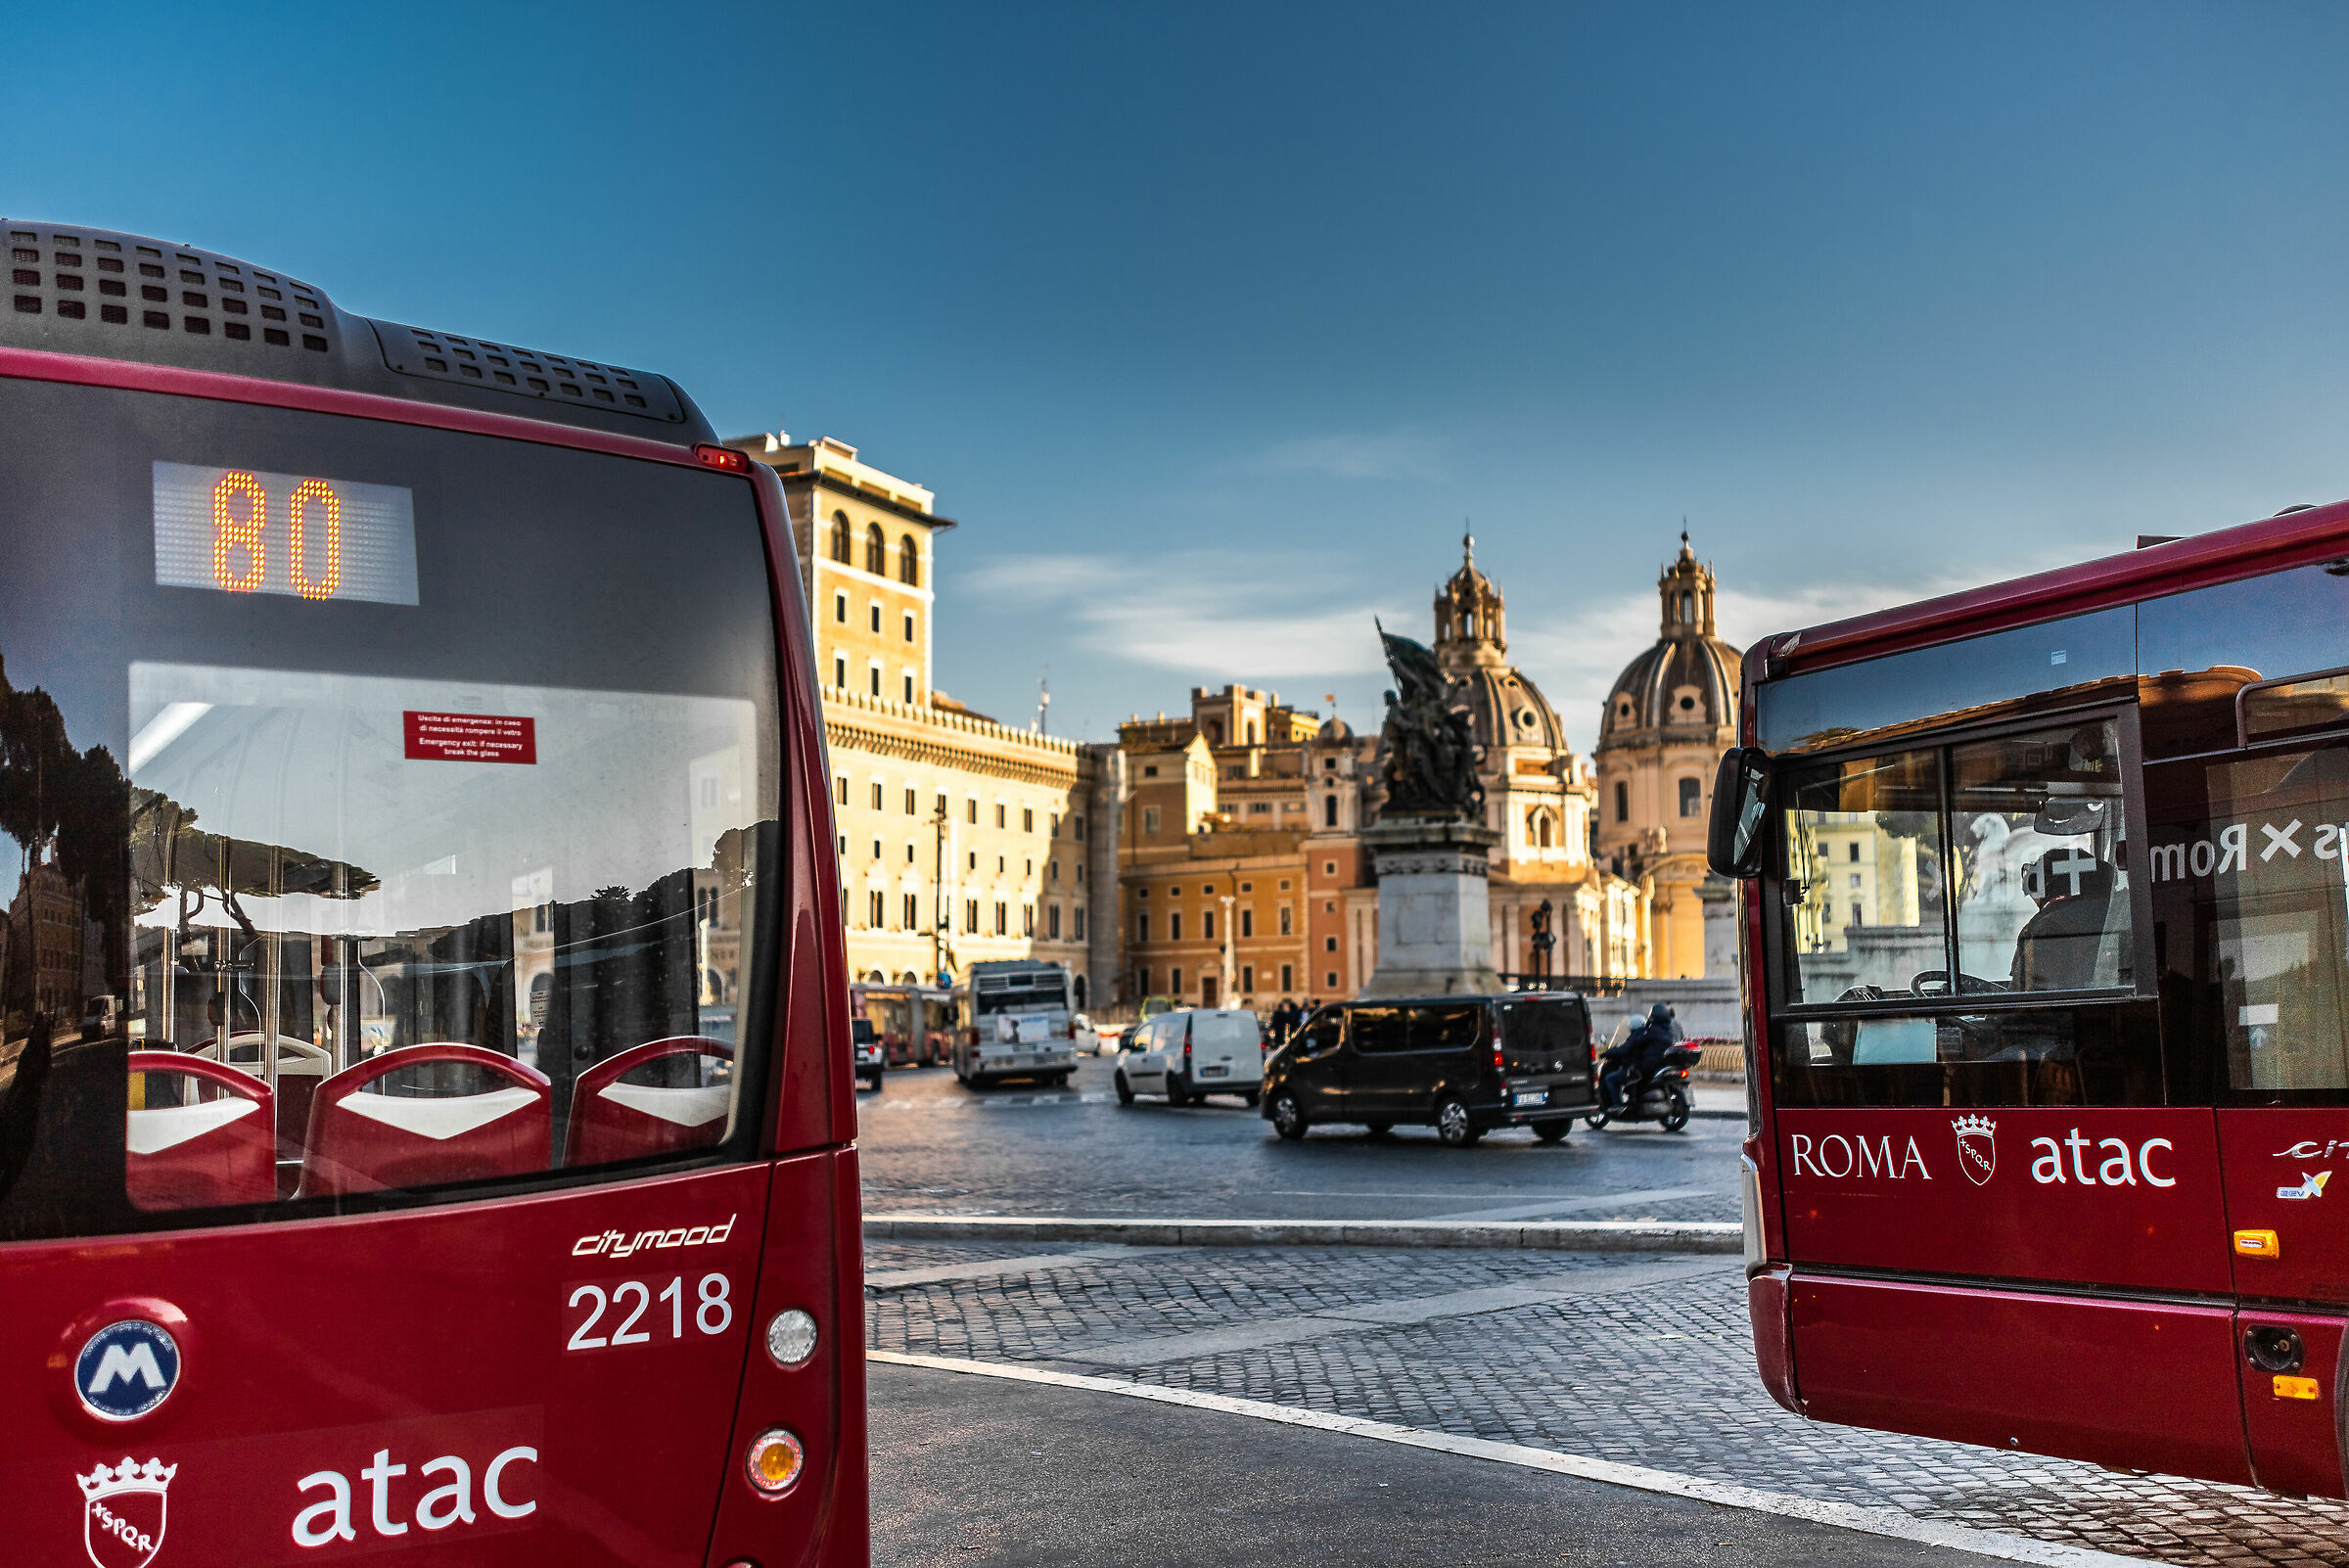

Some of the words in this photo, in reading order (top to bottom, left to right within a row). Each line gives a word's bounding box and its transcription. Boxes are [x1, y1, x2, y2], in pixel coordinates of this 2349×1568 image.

[213, 471, 340, 601] 80
[419, 737, 461, 747] Emergency
[486, 741, 524, 751] necessary
[480, 749, 500, 758] glass
[1791, 1133, 1933, 1180] ROMA
[2031, 1127, 2177, 1188] atac
[572, 1213, 738, 1259] citymood
[567, 1272, 733, 1351] 2218
[88, 1342, 167, 1394] M
[292, 1446, 539, 1548] atac
[101, 1510, 155, 1552] SPQR
